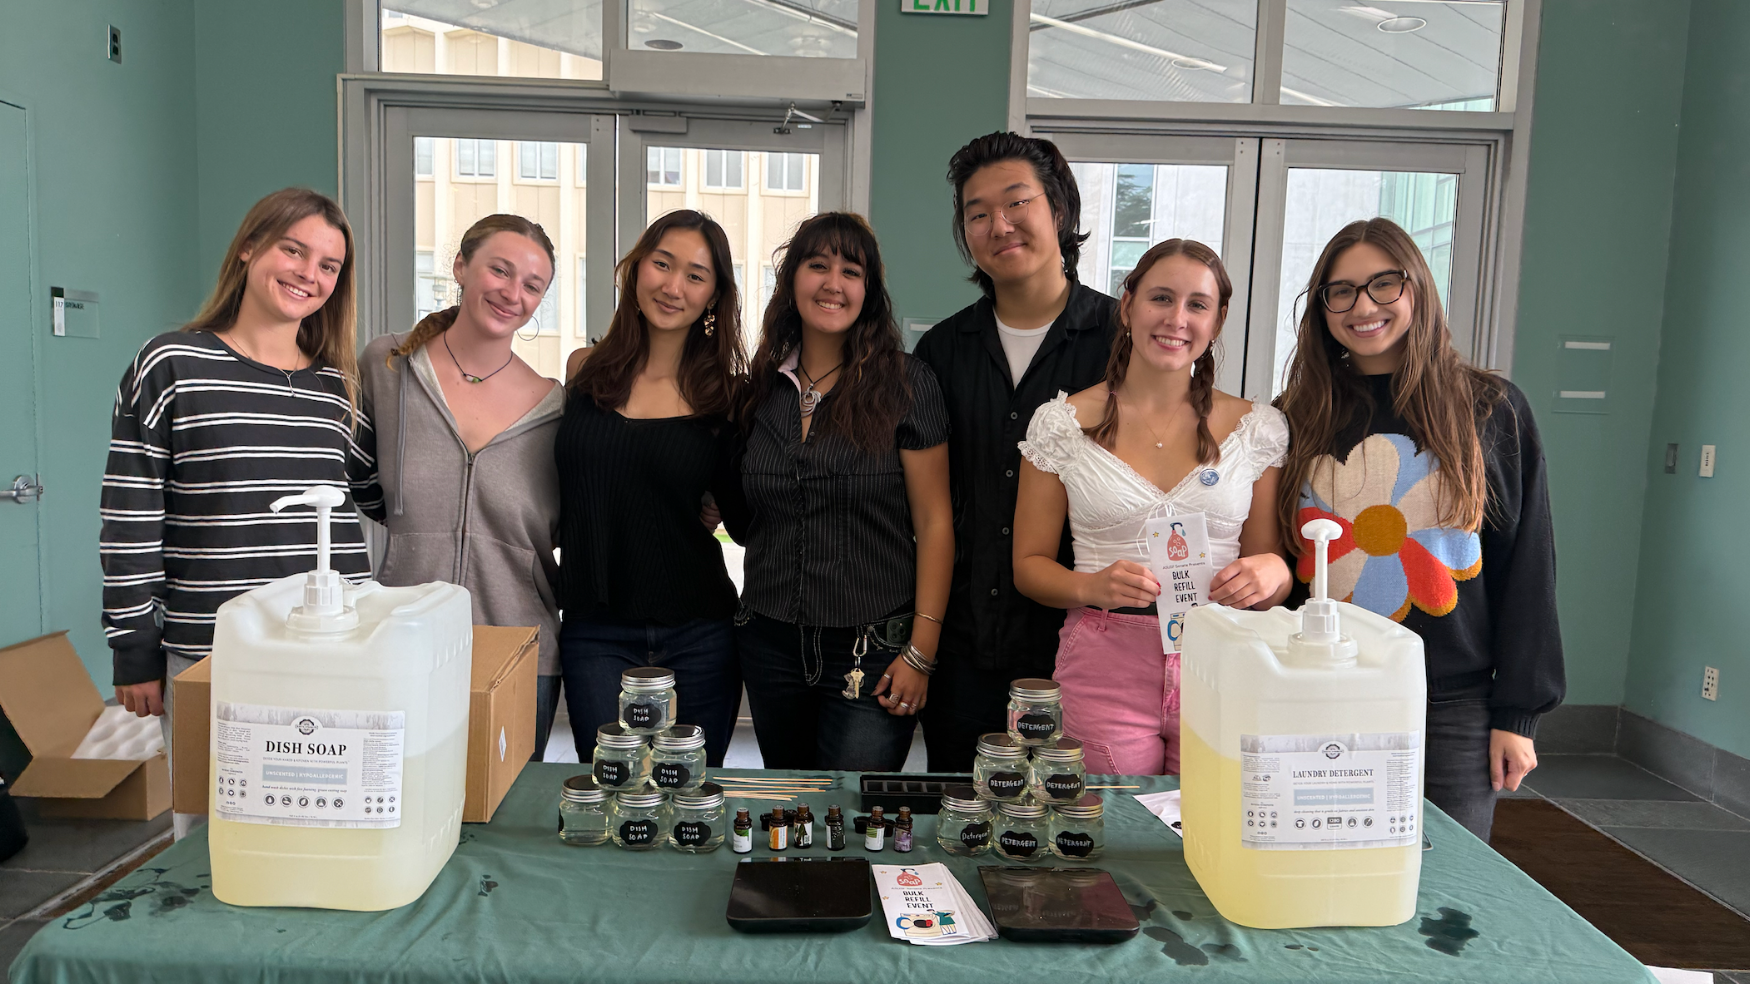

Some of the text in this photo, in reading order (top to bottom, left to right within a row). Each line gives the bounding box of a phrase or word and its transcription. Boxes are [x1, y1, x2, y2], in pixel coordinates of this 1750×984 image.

[1172, 570, 1190, 580] BULK
[1174, 581, 1196, 592] REFILL
[1175, 592, 1198, 603] EVENT
[265, 740, 303, 754] DISH
[307, 743, 347, 756] SOAP
[602, 764, 618, 773] DISH
[661, 768, 678, 776] DISH
[265, 770, 295, 778] UNSCENTED
[602, 772, 618, 780] SOAP
[1292, 768, 1374, 779] LAUNDRY DETERGENT
[660, 776, 678, 784] SOAP
[628, 833, 648, 841] SOAP
